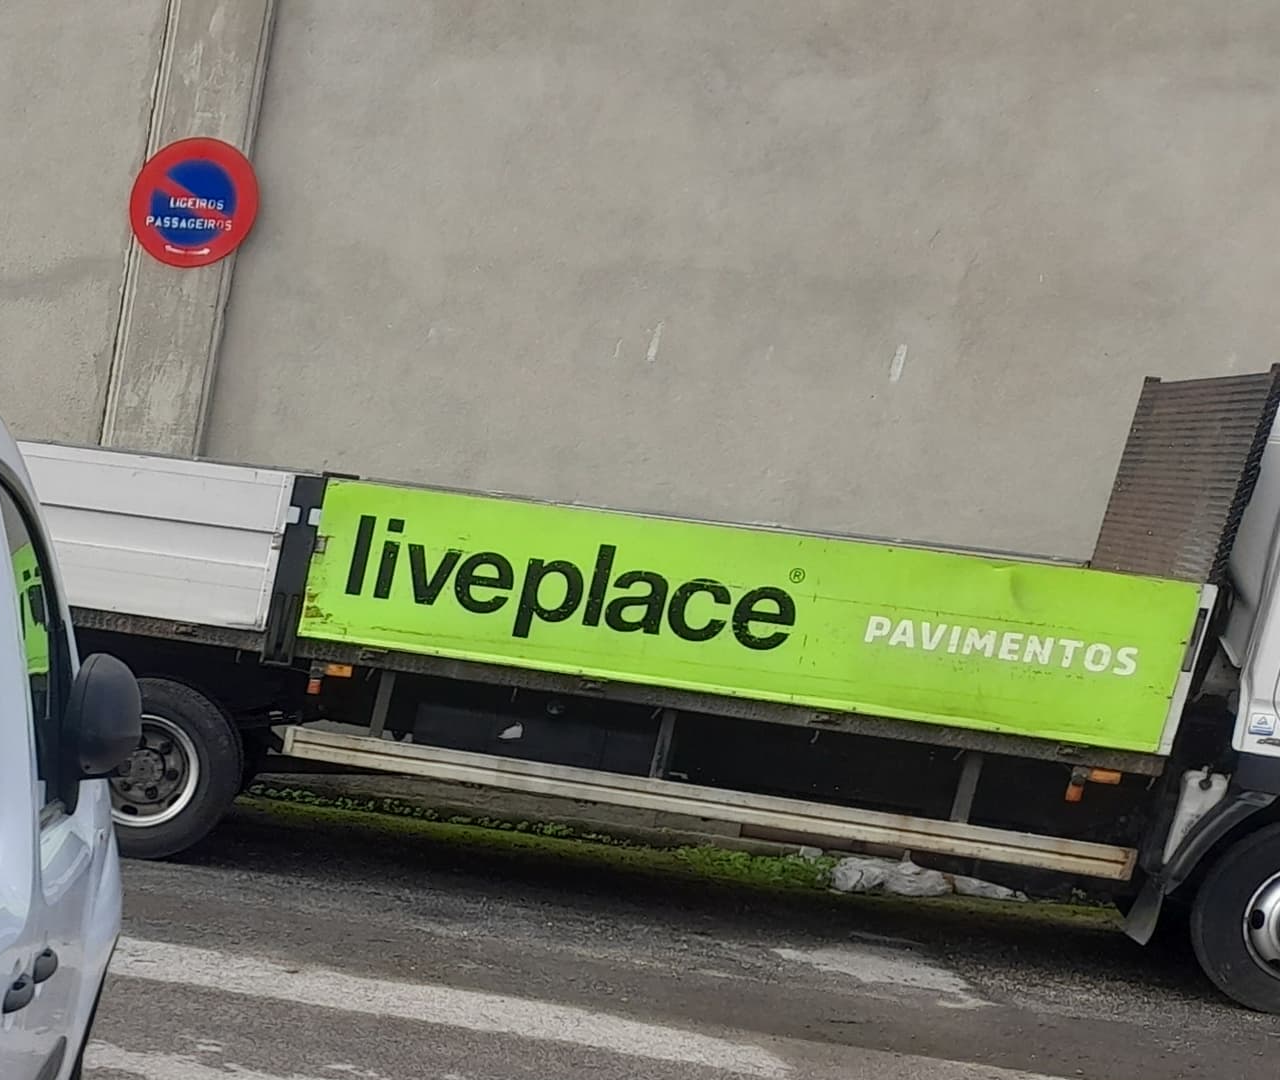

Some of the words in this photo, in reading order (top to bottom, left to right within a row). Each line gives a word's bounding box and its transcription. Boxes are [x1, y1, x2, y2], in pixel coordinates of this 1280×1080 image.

[146, 215, 233, 232] PASSAGEIROS
[169, 196, 224, 211] LIGEIROS
[345, 514, 797, 651] liveplace
[863, 615, 1141, 678] PAVIMENTOS
